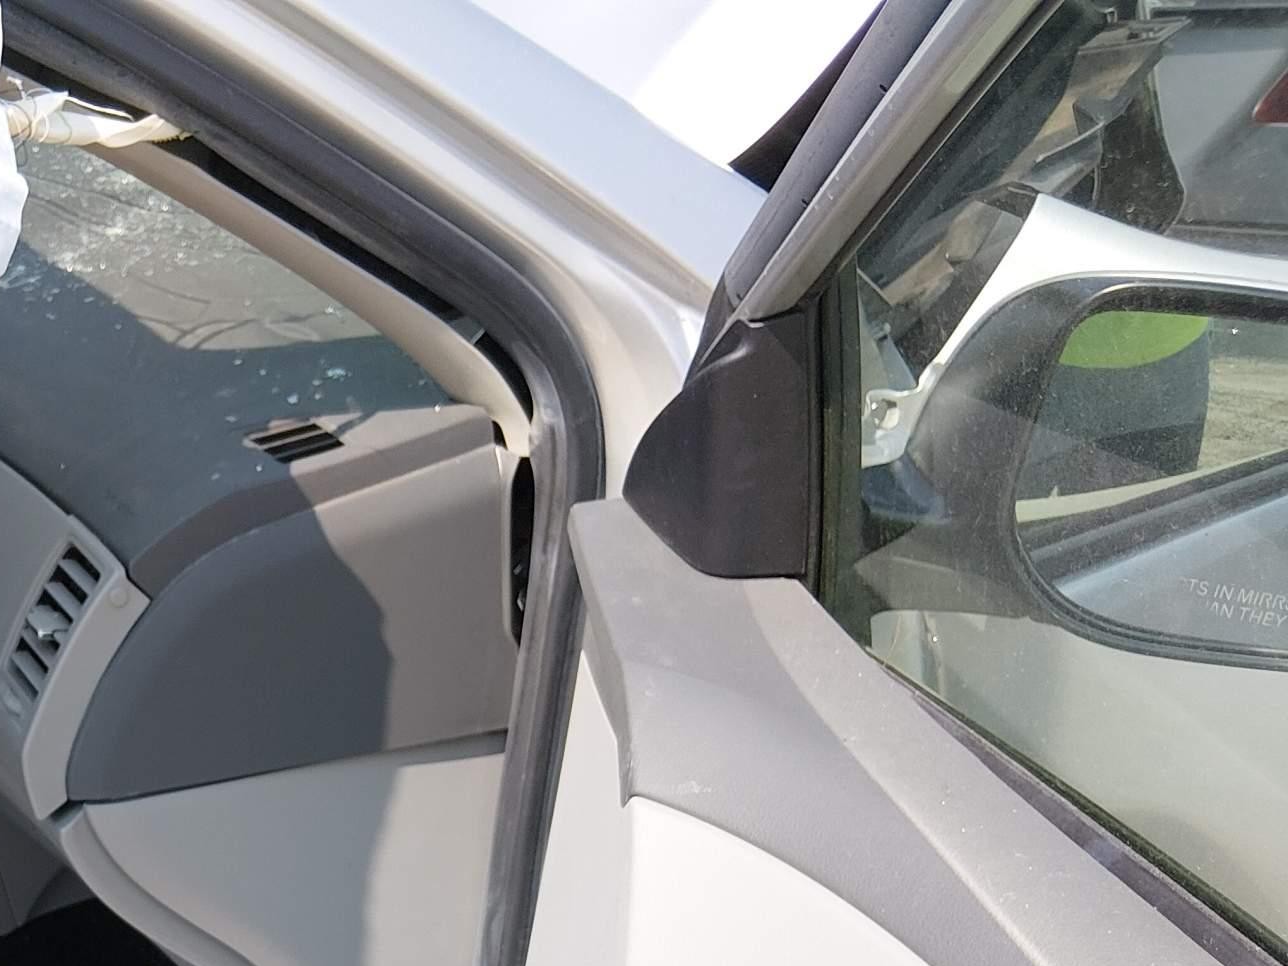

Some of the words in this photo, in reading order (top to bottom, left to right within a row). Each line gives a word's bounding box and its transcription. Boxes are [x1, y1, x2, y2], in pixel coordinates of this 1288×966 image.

[1214, 583, 1234, 600] IN
[1236, 588, 1288, 610] MIRR
[1240, 606, 1288, 628] THEY
